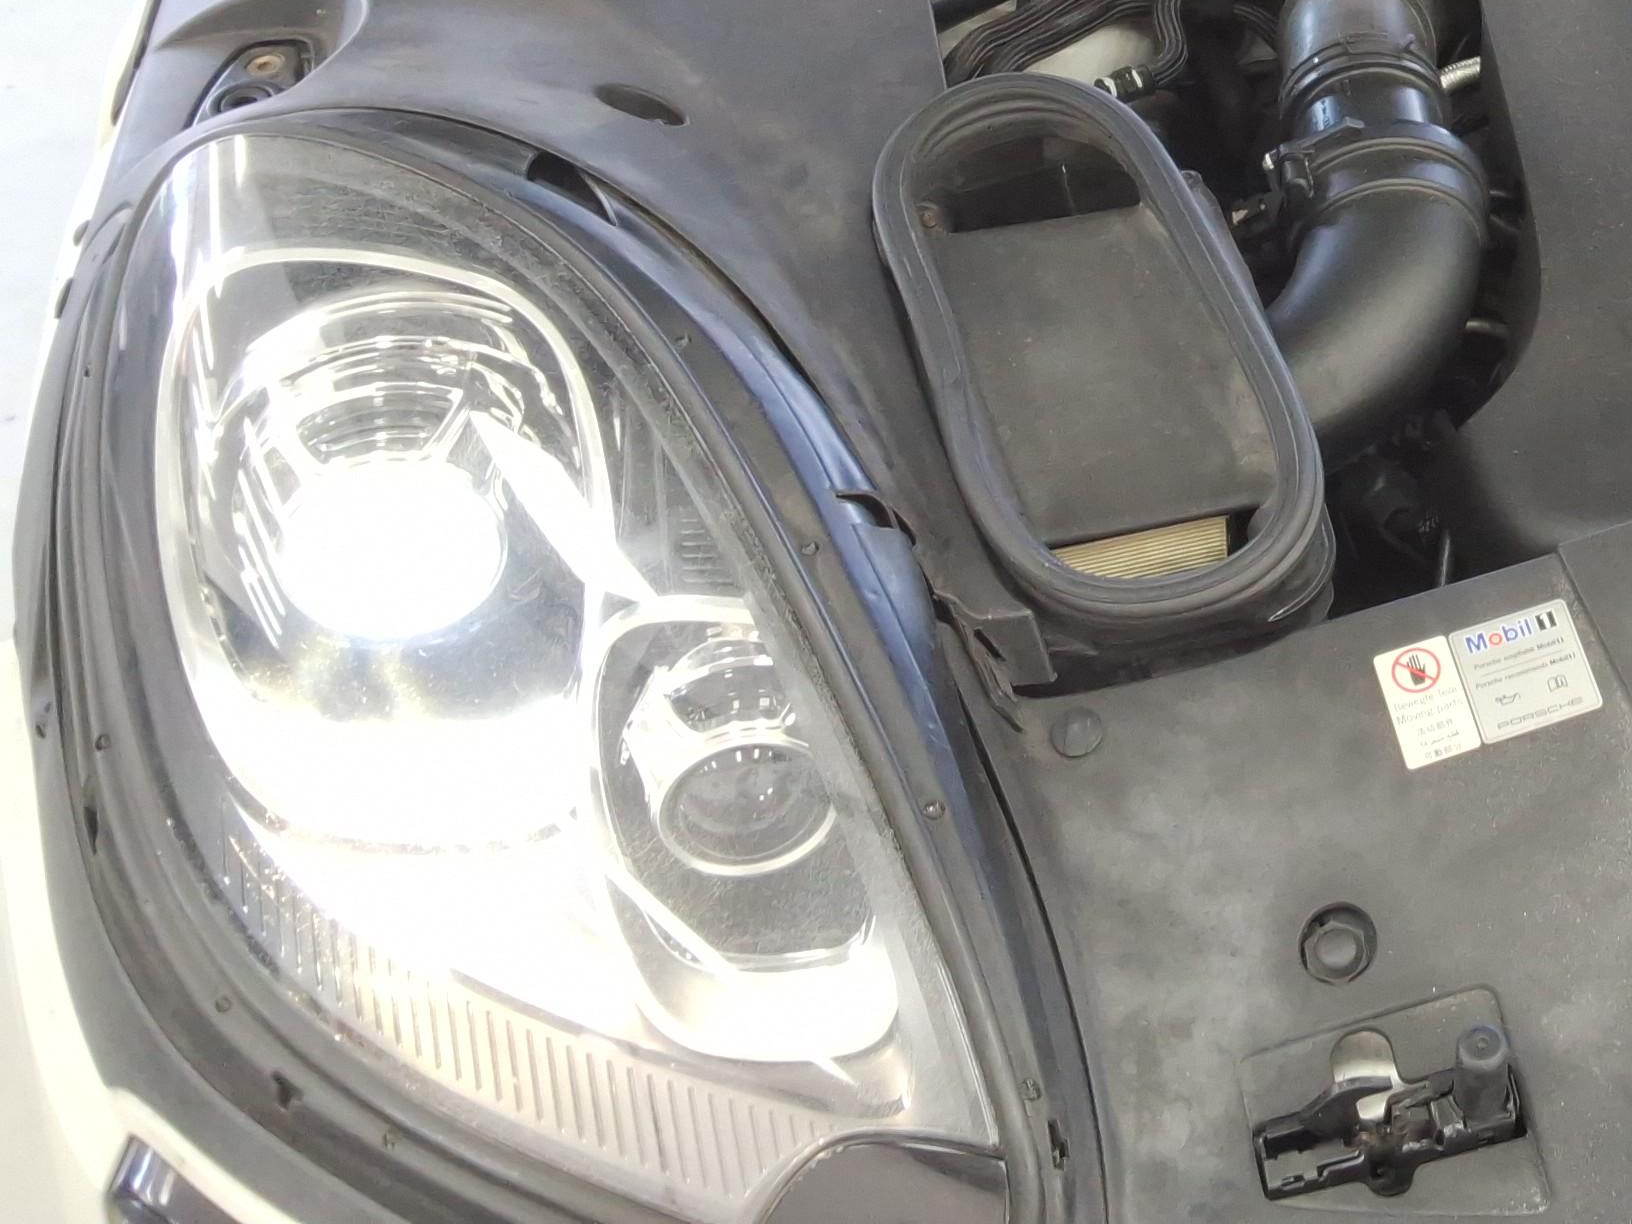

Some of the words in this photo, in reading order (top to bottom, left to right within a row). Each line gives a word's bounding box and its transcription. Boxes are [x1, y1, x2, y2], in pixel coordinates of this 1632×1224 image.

[1465, 618, 1533, 653] Mobil
[1535, 610, 1557, 631] 1
[1497, 696, 1583, 729] PORSCHE
